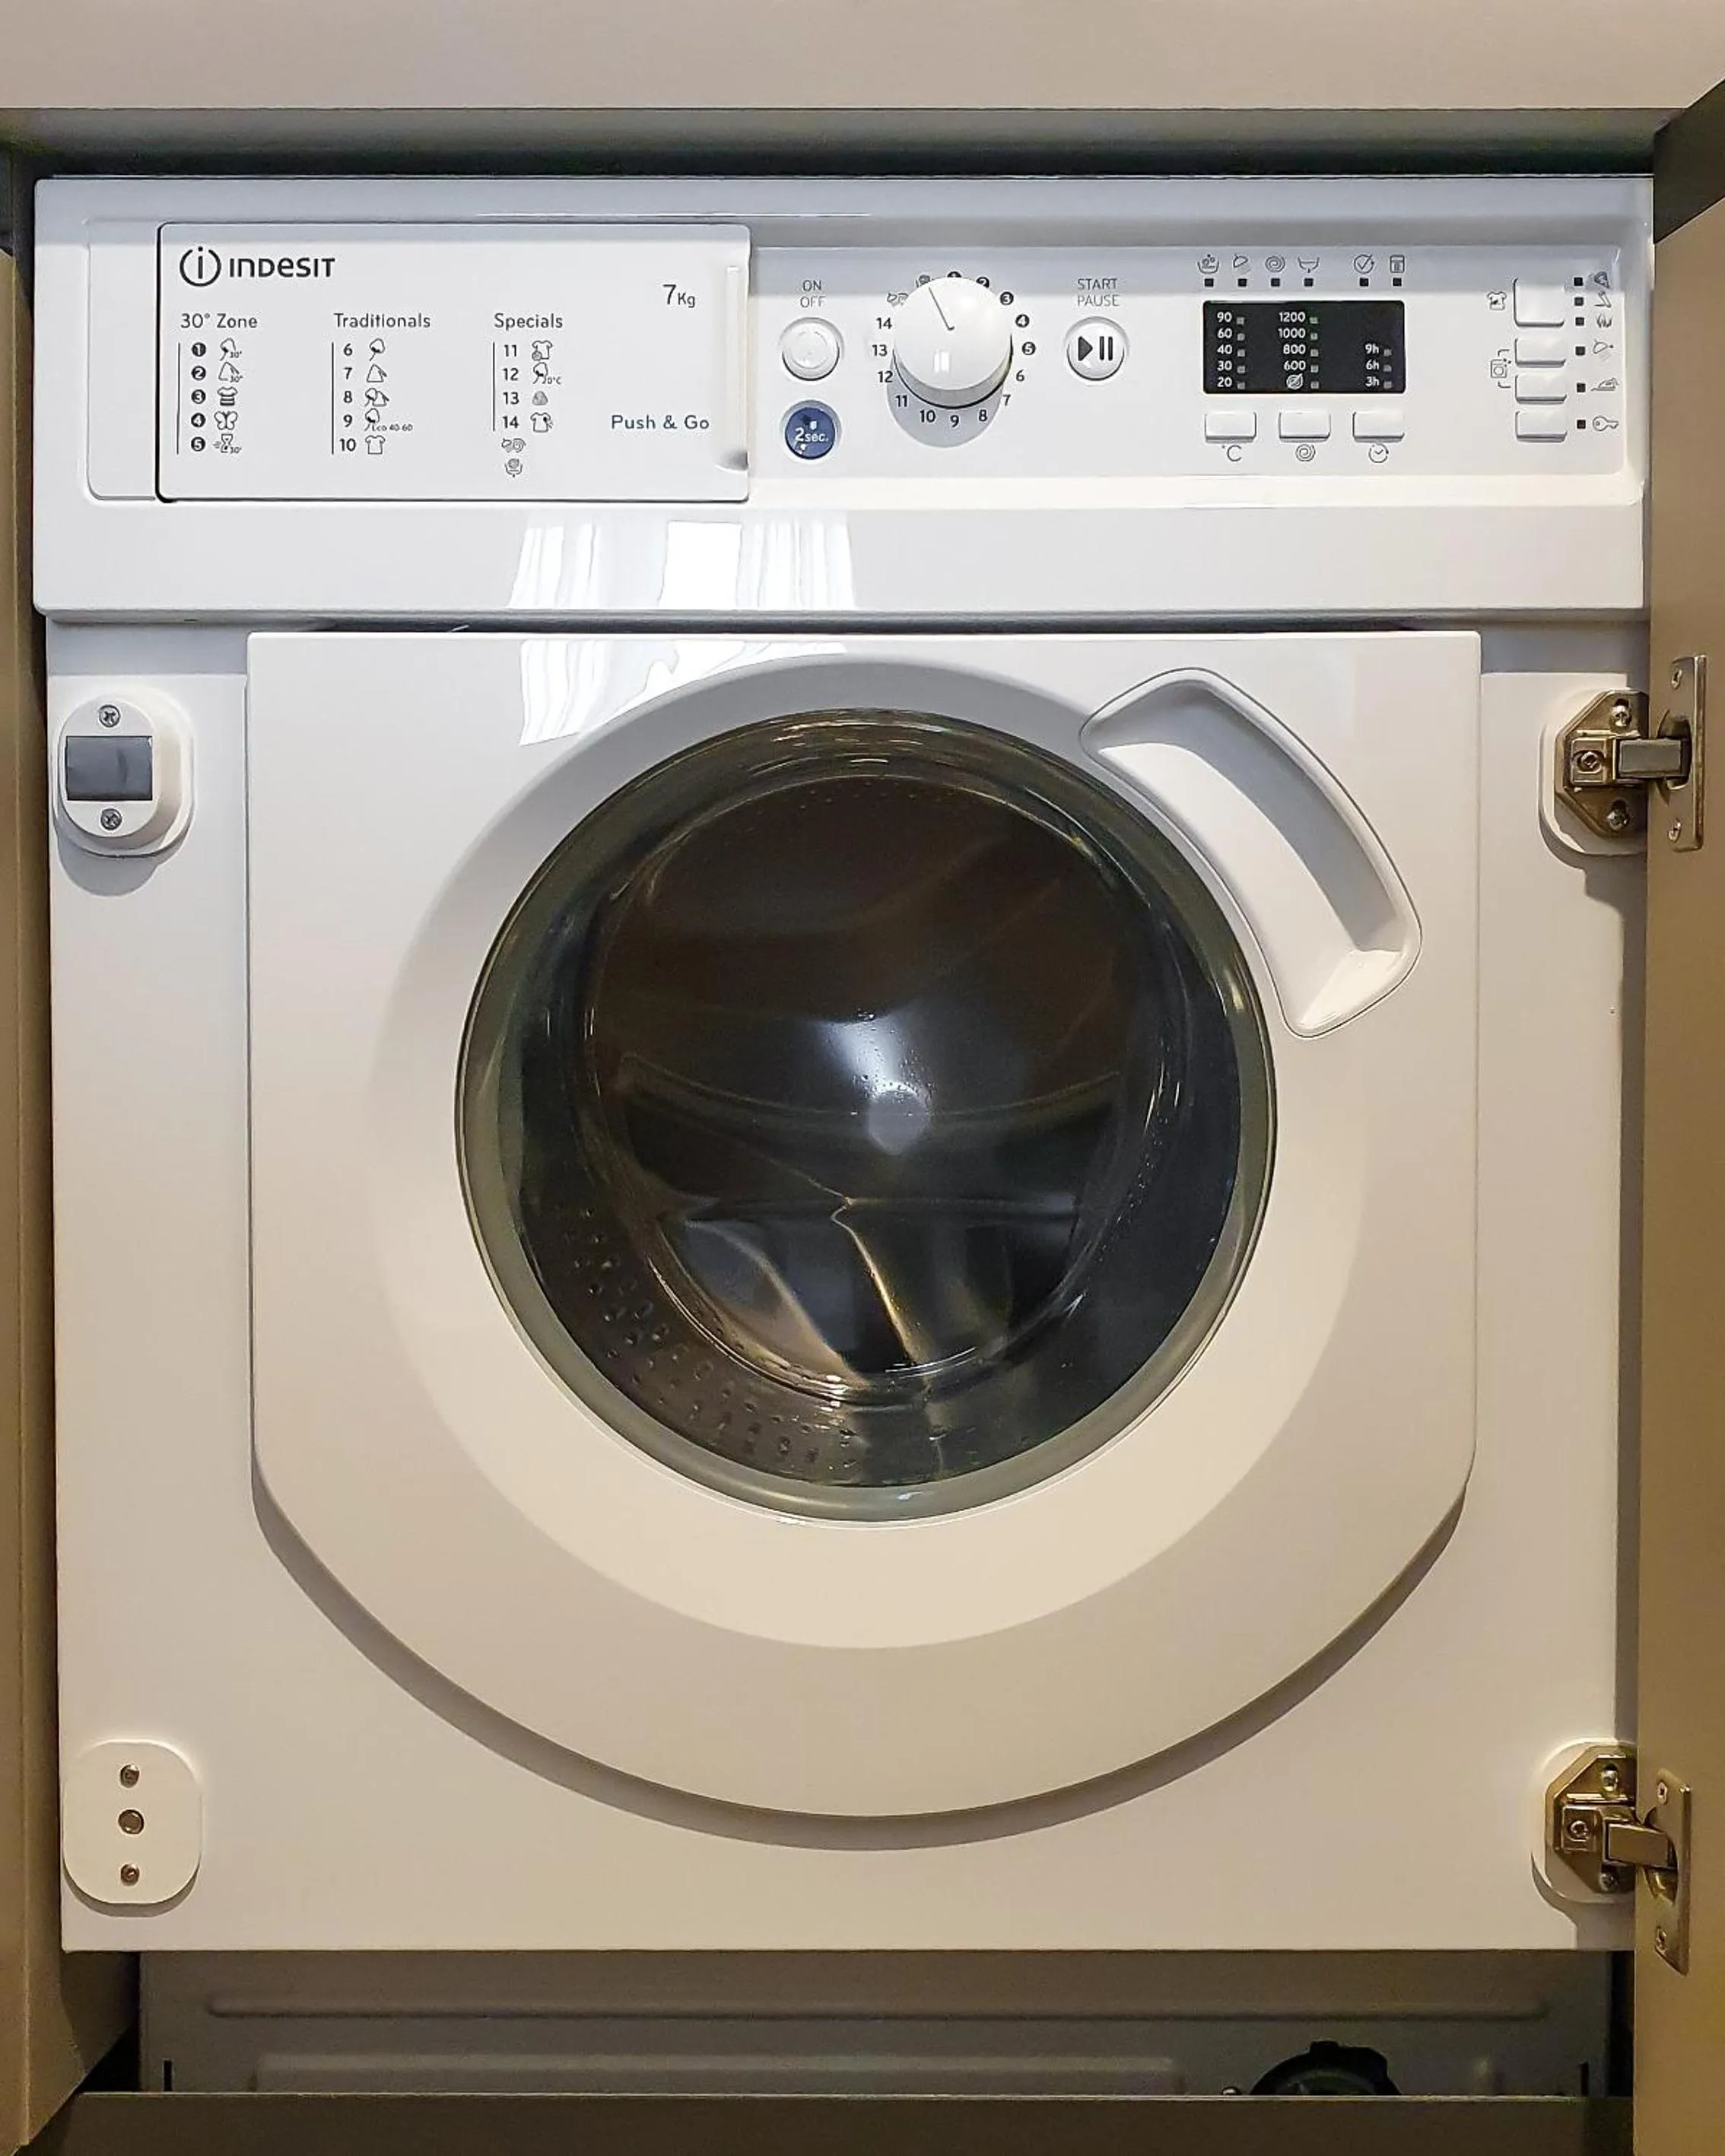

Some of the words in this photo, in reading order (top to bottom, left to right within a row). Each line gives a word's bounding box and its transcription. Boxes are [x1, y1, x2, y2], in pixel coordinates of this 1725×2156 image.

[229, 257, 335, 278] INDESIT
[802, 279, 821, 291] ON
[1077, 278, 1118, 290] START
[800, 296, 825, 308] OFF
[999, 291, 1014, 306] 3
[1076, 294, 1120, 306] PAUSE
[180, 313, 210, 329] 30°
[217, 313, 258, 329] Zone
[334, 313, 430, 329] Traditionals
[494, 313, 563, 330] Specials
[876, 317, 892, 329] 14
[1015, 314, 1030, 328] 4
[1217, 311, 1232, 322] 90
[1279, 311, 1306, 322] 1200
[1217, 328, 1232, 339] 60
[1278, 328, 1306, 338] 1000
[192, 342, 206, 357] 1
[343, 343, 353, 357] 6
[504, 345, 517, 357] 11
[872, 345, 888, 357] 13
[1021, 341, 1036, 356] 5
[1217, 344, 1233, 355] 40
[1283, 344, 1306, 355] 800
[1365, 344, 1380, 355] 9h
[1217, 360, 1232, 371] 30
[1284, 360, 1306, 371] 600
[1366, 360, 1380, 371] 6h
[192, 366, 206, 380] 2
[344, 367, 353, 379] 7
[502, 367, 519, 380] 12
[878, 370, 894, 383] 12
[1015, 370, 1025, 382] 6
[1217, 376, 1232, 388] 20
[1366, 376, 1380, 387] 3h
[192, 389, 206, 404] 3
[343, 391, 353, 404] 8
[502, 392, 519, 405] 13
[895, 395, 908, 408] 11
[1003, 394, 1012, 406] 7
[191, 413, 205, 427] 4
[343, 414, 353, 427] 9
[502, 415, 519, 429] 14
[611, 414, 656, 430] Push
[662, 415, 677, 430] &
[684, 415, 710, 430] Go
[920, 409, 936, 423] 10
[950, 415, 959, 427] 9
[979, 409, 988, 422] 8
[191, 437, 206, 452] 5
[339, 438, 357, 452] 10
